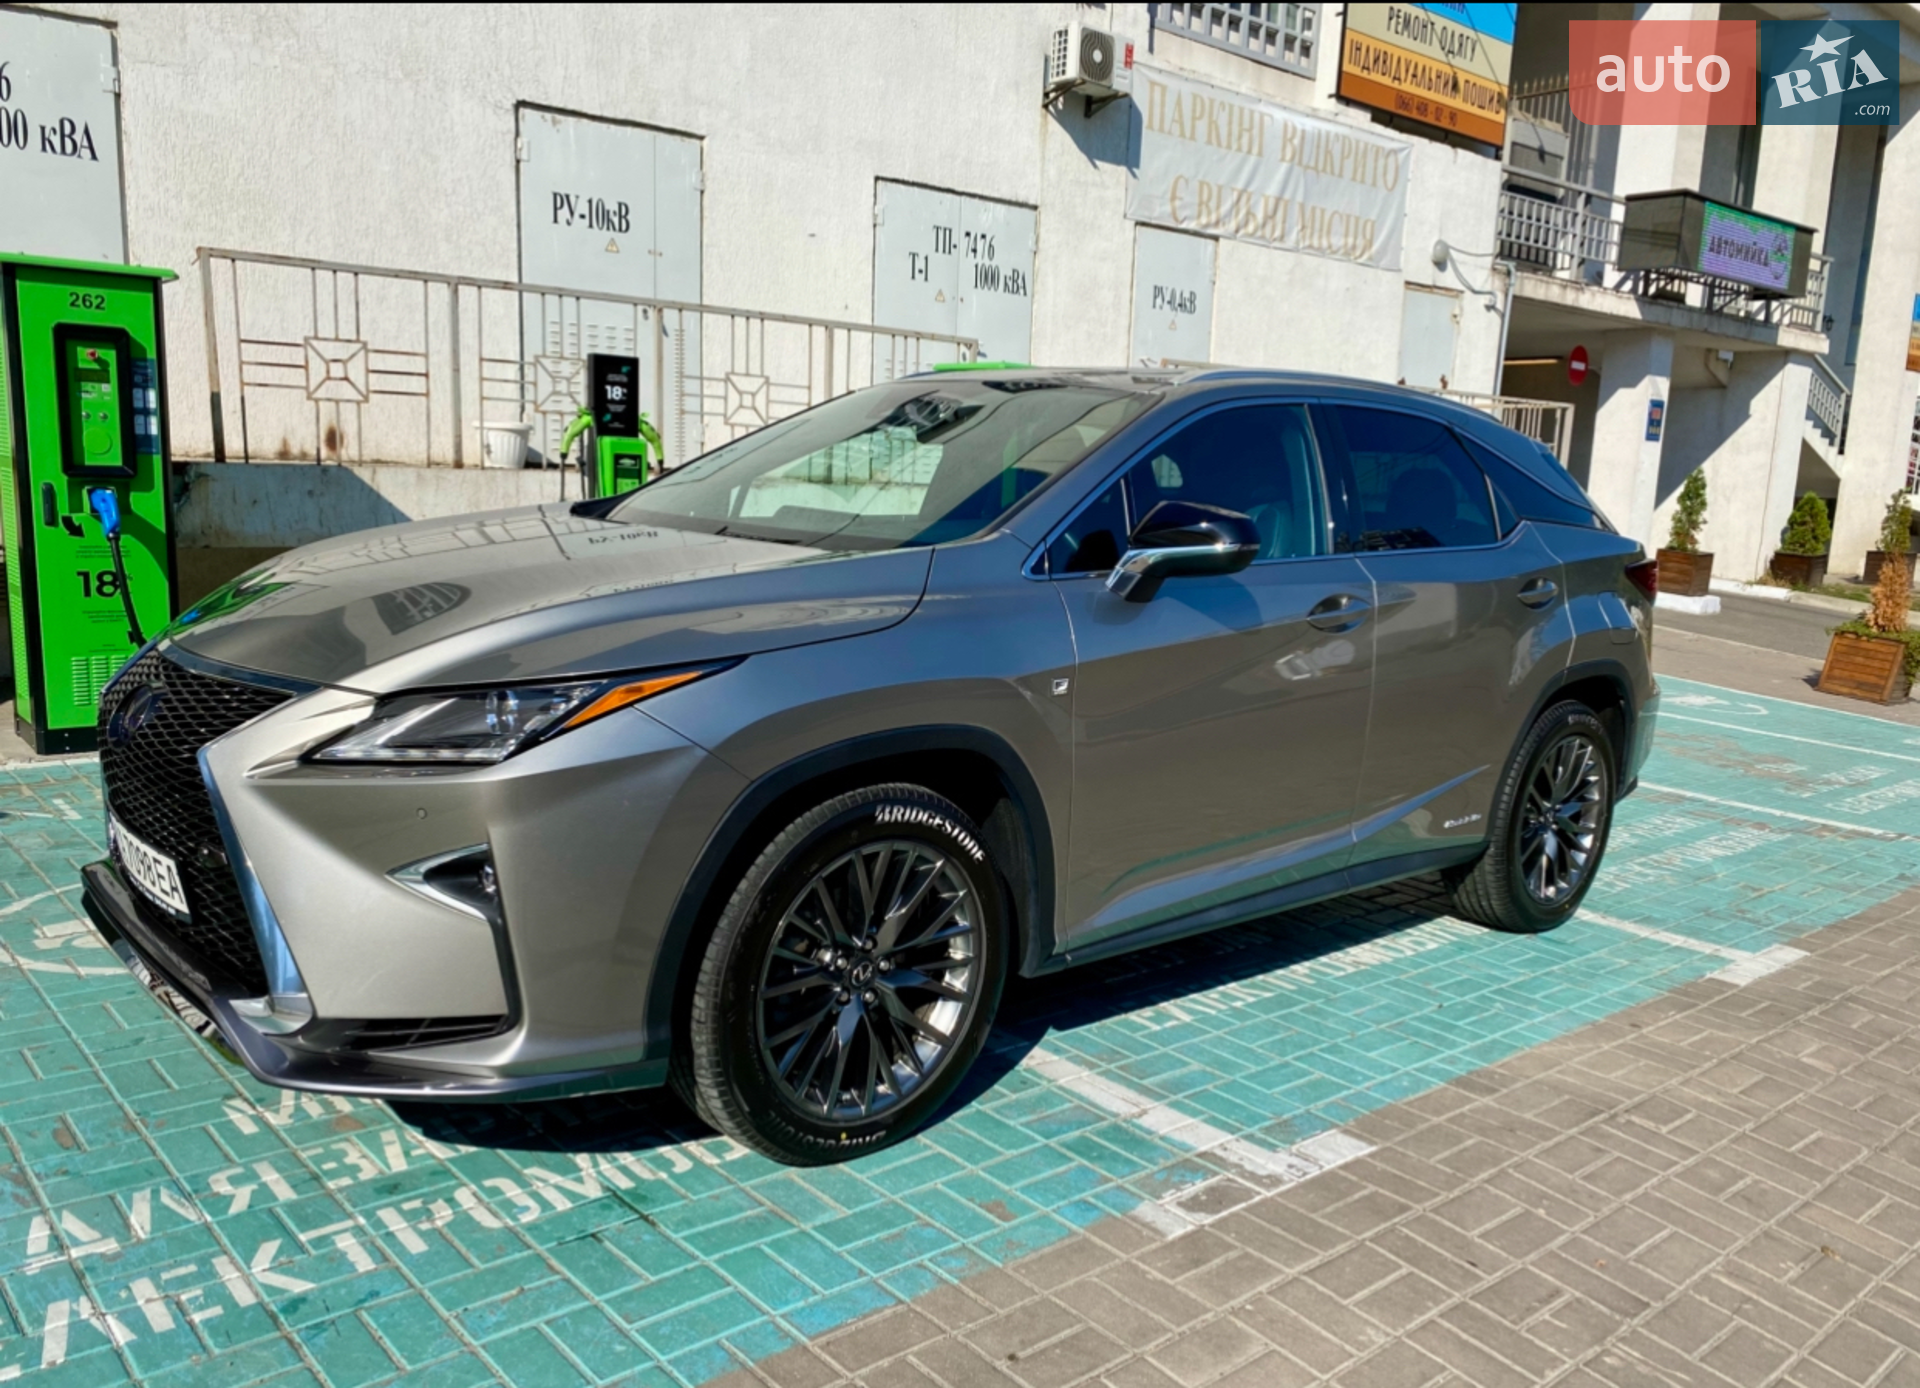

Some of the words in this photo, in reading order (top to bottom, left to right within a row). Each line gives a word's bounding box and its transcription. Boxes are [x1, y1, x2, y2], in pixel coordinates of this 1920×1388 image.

[1387, 6, 1434, 46] РЕМОНТ
[1441, 26, 1477, 62] ОДЯГУ
[1462, 79, 1503, 115] ПОШИВ
[39, 116, 99, 162] кВА
[1145, 80, 1275, 158] ПАРКІНГ
[1279, 118, 1399, 192] ВІДКРИТО
[552, 191, 630, 234] РУ-10кВ
[1169, 174, 1189, 225] Є
[1197, 180, 1290, 243] ВІЛЬНІ
[1296, 202, 1376, 261] МІСЦЯ
[909, 251, 929, 282] Т-1
[974, 262, 1000, 292] 1000
[1003, 268, 1027, 297] кВА
[69, 292, 106, 311] 262
[604, 385, 622, 401] 18
[76, 569, 122, 598] 18
[875, 804, 986, 864] BRIDGESTONE
